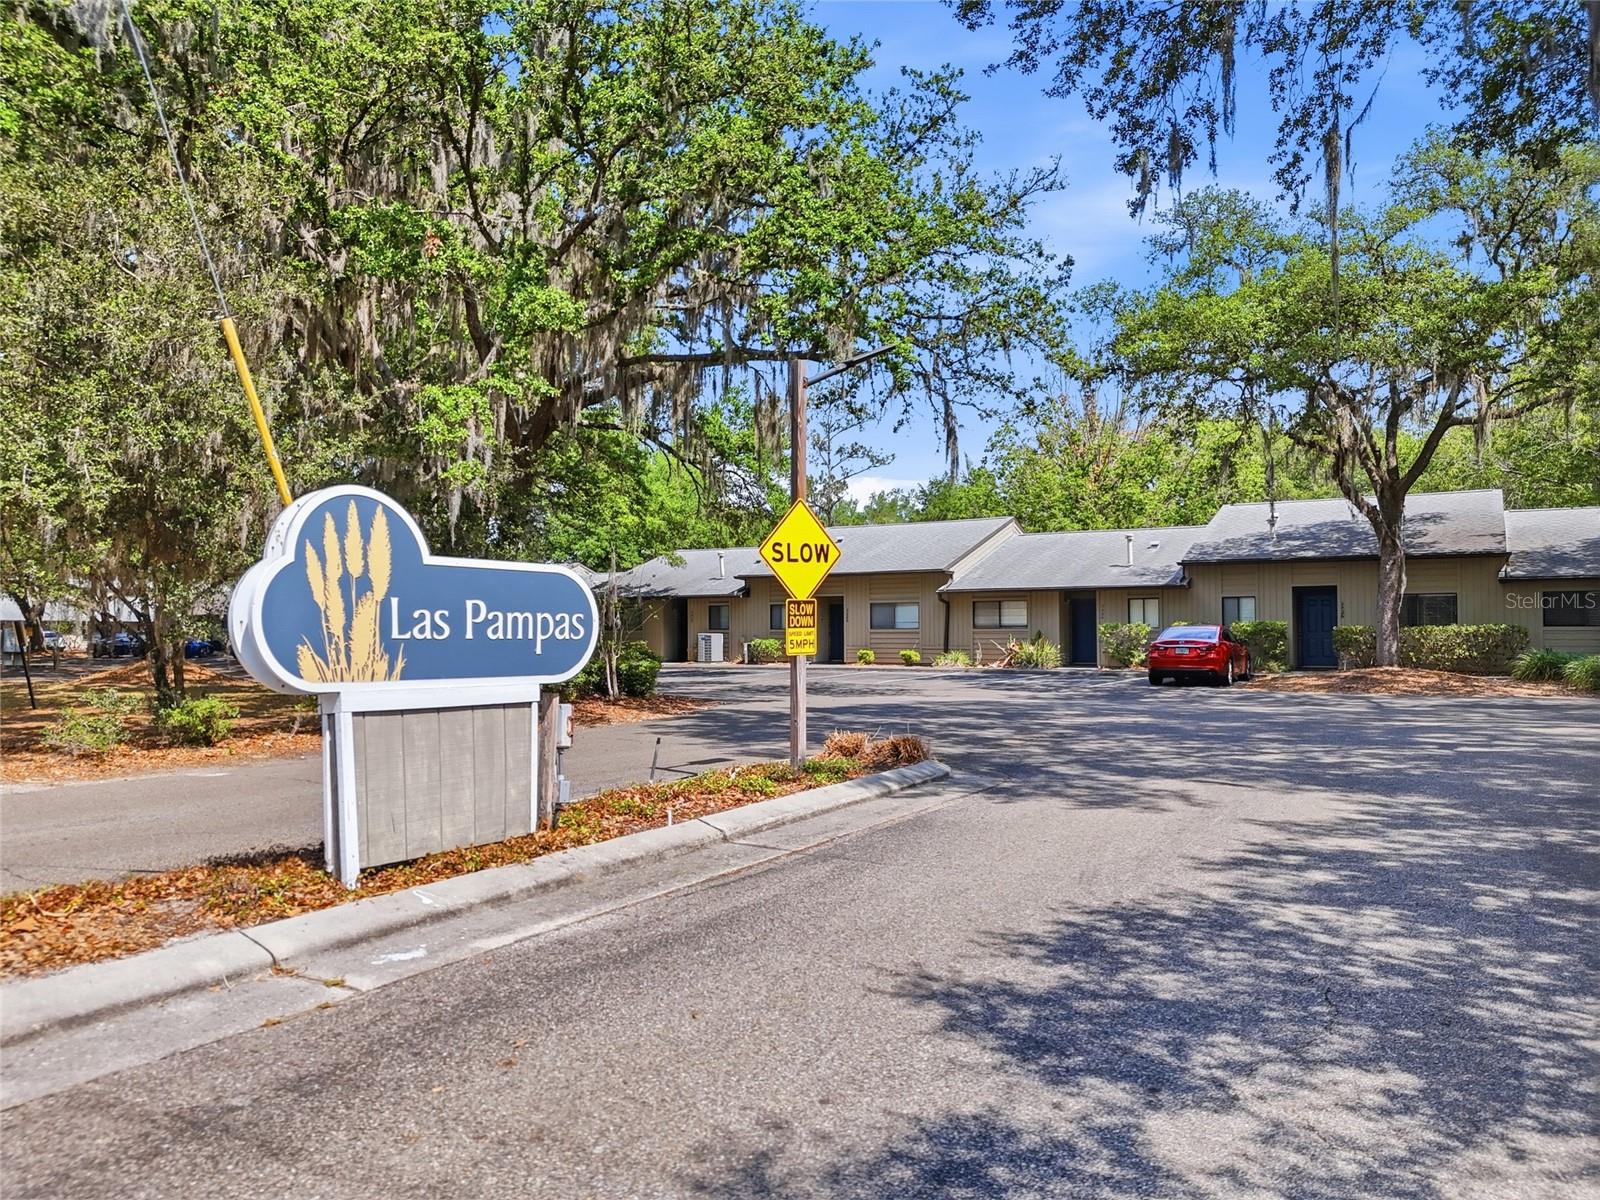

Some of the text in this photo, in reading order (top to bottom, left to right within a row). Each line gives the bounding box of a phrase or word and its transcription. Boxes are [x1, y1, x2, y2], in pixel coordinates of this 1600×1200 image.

[772, 542, 830, 563] SLOW
[789, 604, 814, 615] SLOW
[390, 597, 584, 654] Las Pampas
[789, 616, 814, 627] DOWN
